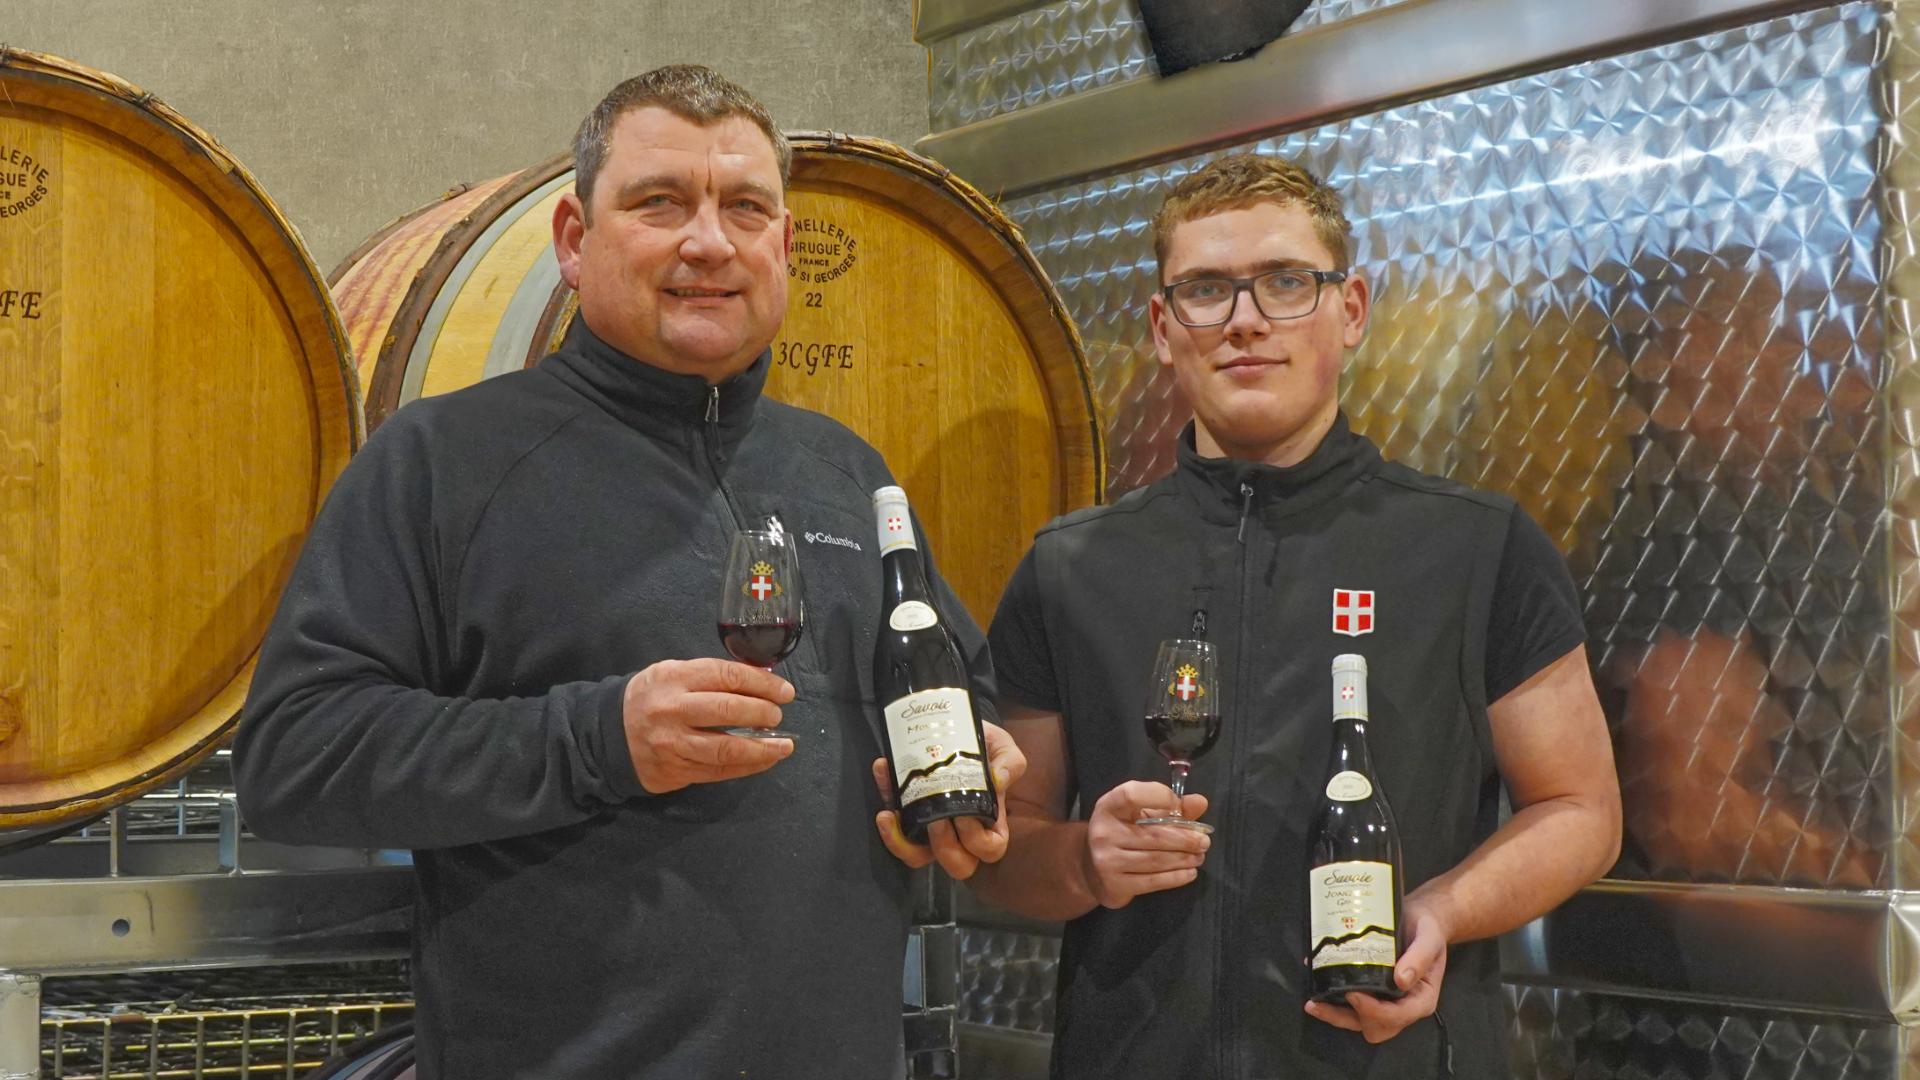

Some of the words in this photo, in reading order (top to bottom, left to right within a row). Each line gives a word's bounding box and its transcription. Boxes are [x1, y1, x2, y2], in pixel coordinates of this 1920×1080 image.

[799, 257, 829, 267] FRANCE
[814, 253, 857, 284] GEORGES
[805, 292, 823, 308] 22
[777, 342, 854, 376] 3CGFE
[815, 532, 862, 551] Columbia
[901, 699, 952, 719] Savoie
[1323, 869, 1375, 886] Savoie
